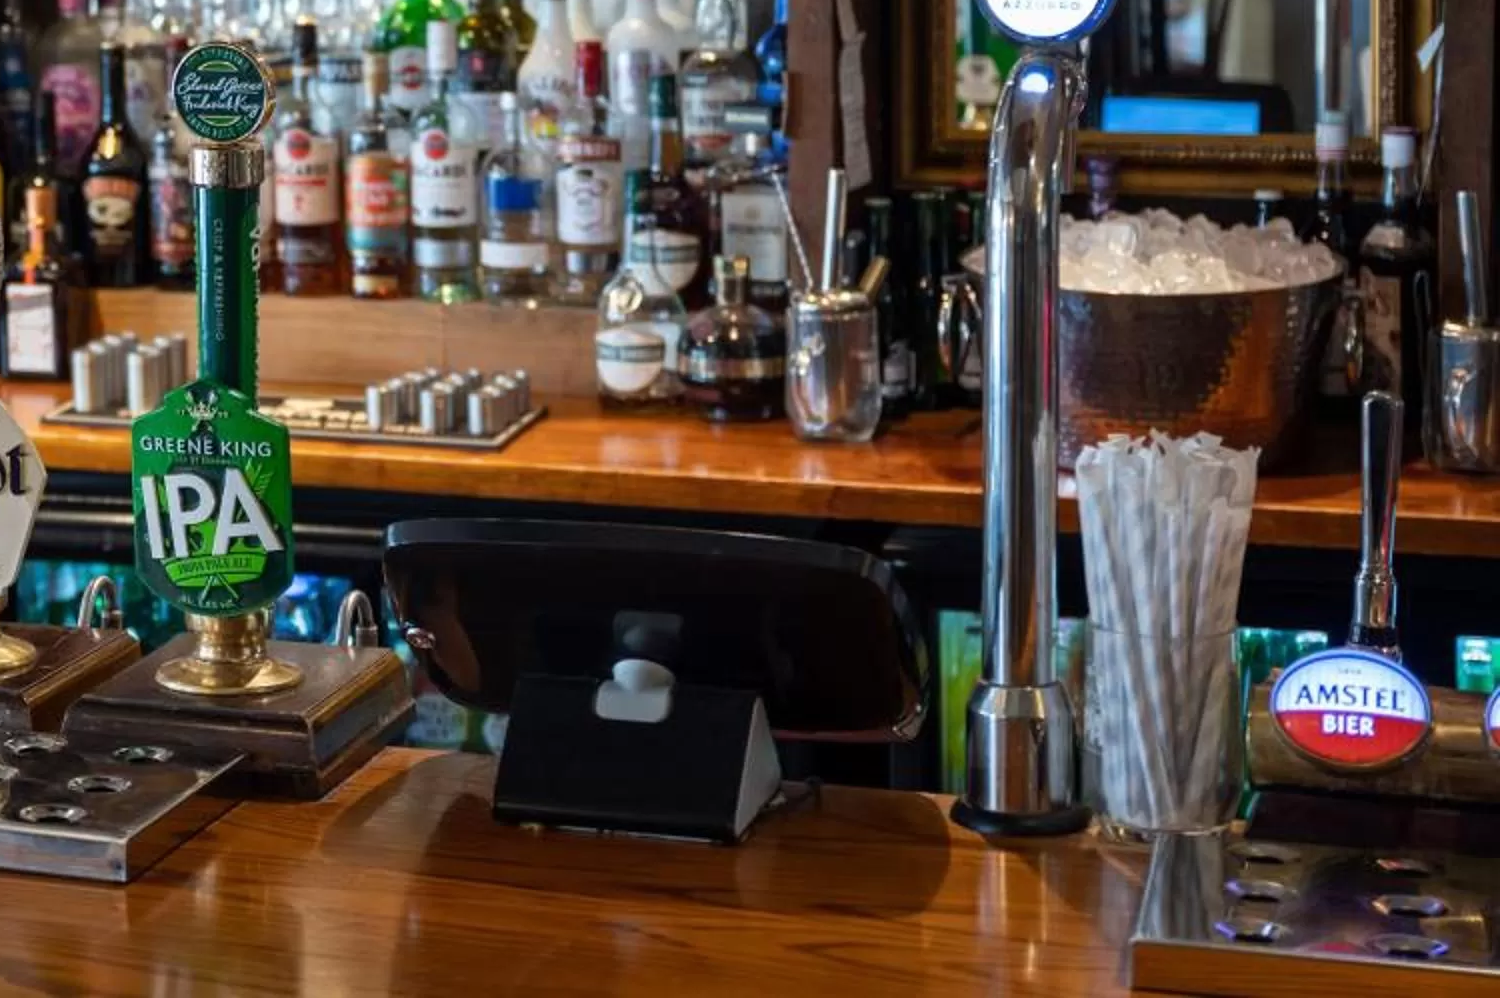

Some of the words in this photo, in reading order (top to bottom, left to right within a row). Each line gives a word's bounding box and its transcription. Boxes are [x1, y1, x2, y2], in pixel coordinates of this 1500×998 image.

[139, 434, 214, 456] GREENE
[220, 440, 272, 458] KING
[139, 467, 286, 560] IPA
[1294, 683, 1406, 713] AMSTEL
[1321, 713, 1376, 737] BIER
